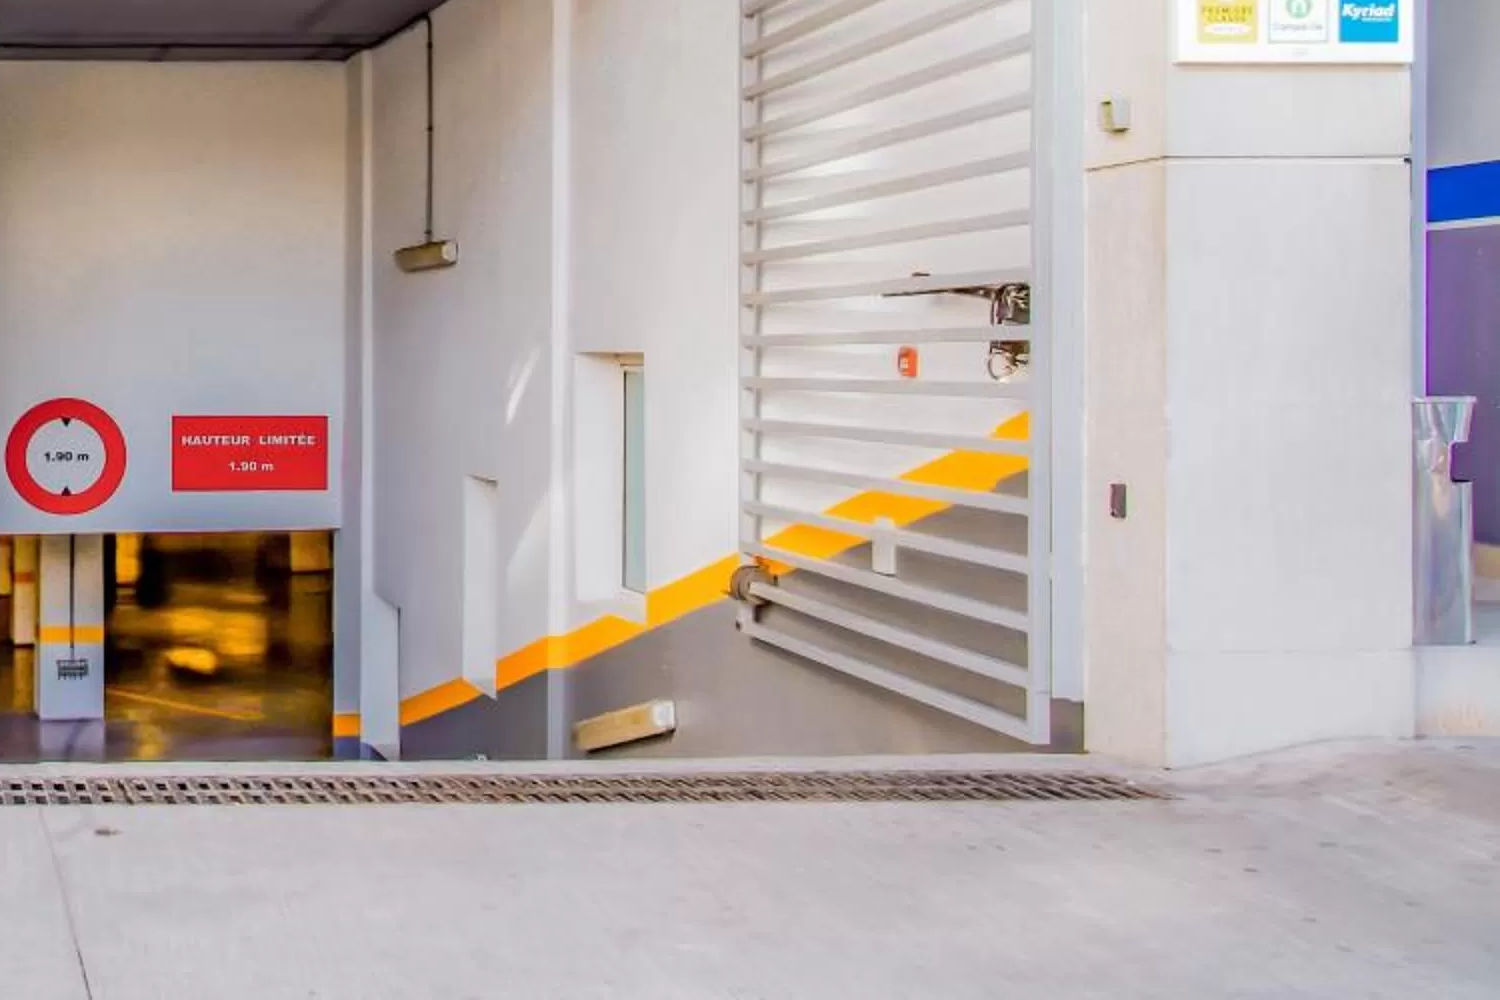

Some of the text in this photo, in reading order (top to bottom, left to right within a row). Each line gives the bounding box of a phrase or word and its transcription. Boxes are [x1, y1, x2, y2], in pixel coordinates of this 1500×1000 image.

[1342, 3, 1395, 20] Kyriad
[181, 435, 250, 446] HAUTEUR
[44, 452, 90, 462] 1.90 m
[228, 461, 275, 472] 1.90 m
